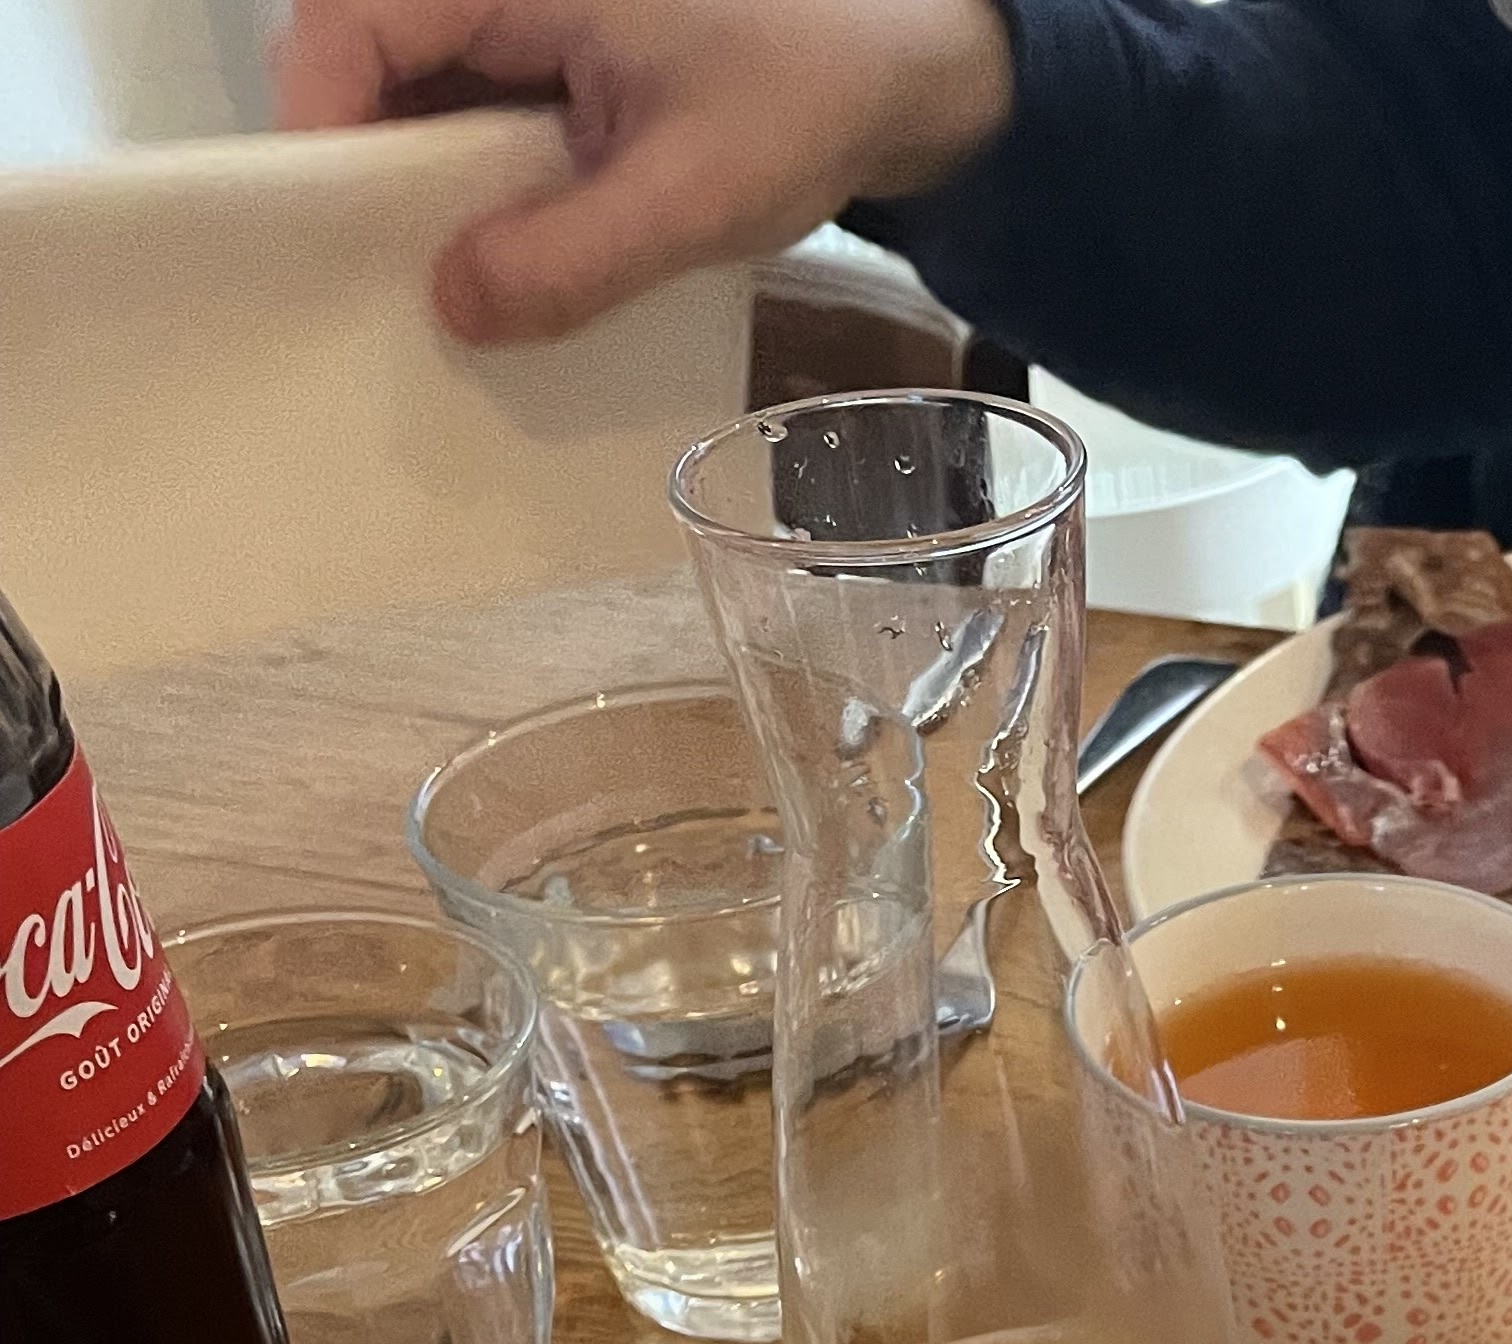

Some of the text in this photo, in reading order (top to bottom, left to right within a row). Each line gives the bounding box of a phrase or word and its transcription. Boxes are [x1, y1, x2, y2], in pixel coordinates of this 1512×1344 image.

[59, 967, 172, 1090] GOÛT ORIGINA
[66, 1103, 146, 1158] Délicieux
[147, 1091, 157, 1106] &
